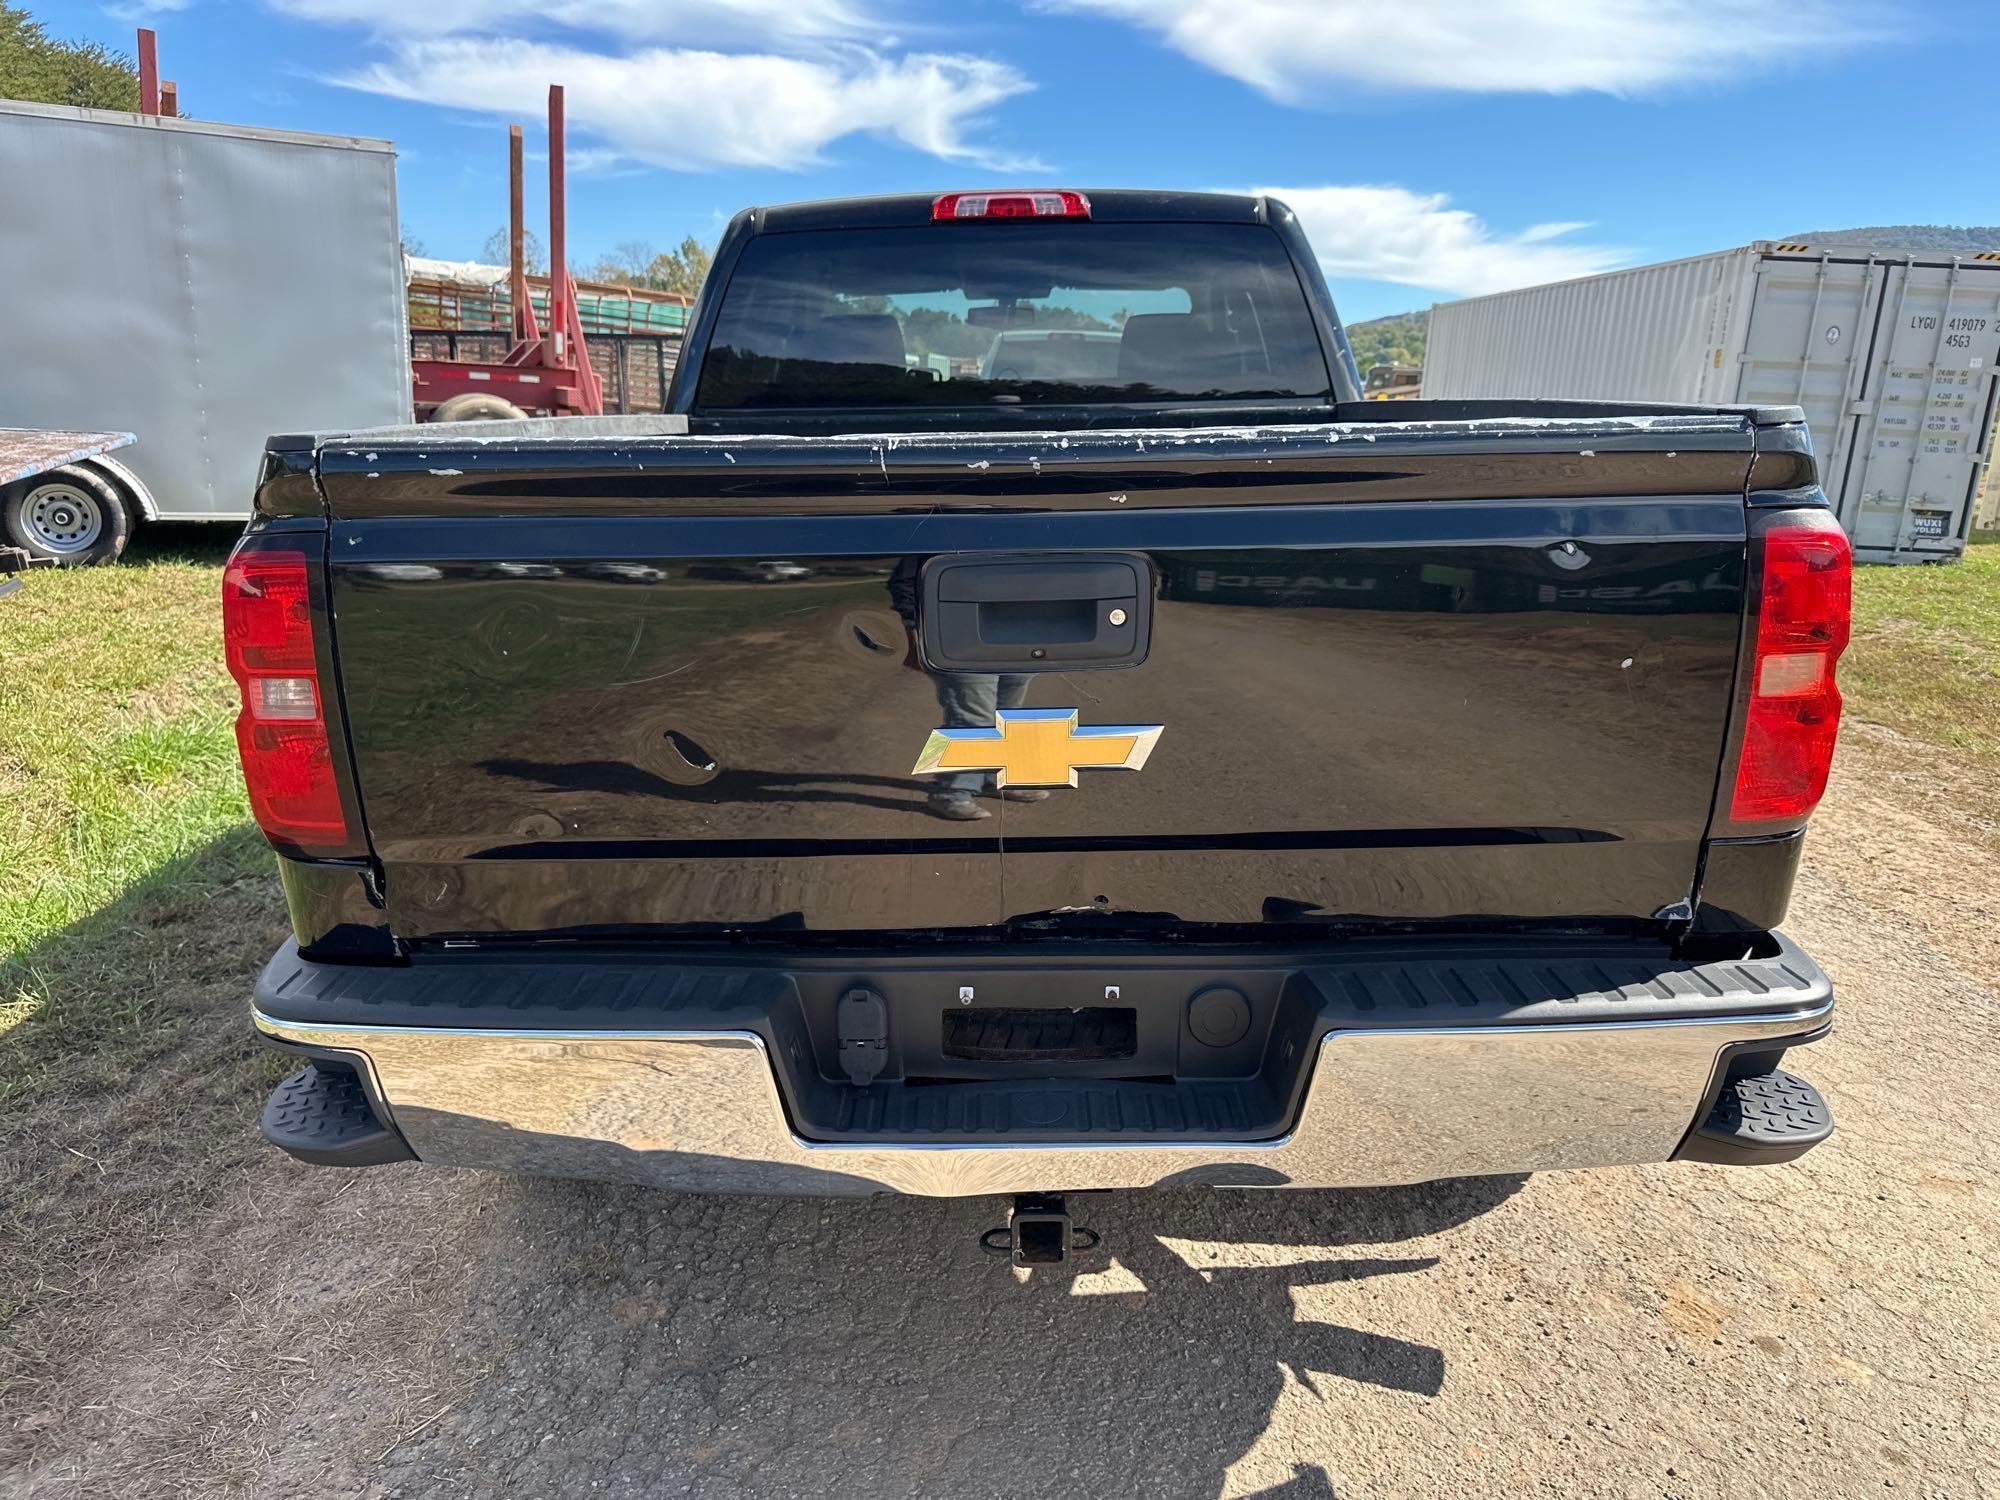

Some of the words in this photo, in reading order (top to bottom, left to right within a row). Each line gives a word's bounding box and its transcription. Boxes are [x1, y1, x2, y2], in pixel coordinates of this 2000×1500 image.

[1911, 316, 1937, 330] LYGU
[1949, 318, 1987, 331] 419079
[1946, 335, 1971, 348] 45G3
[1884, 417, 1907, 425] PAYLOAD
[1915, 518, 1942, 527] WUXI
